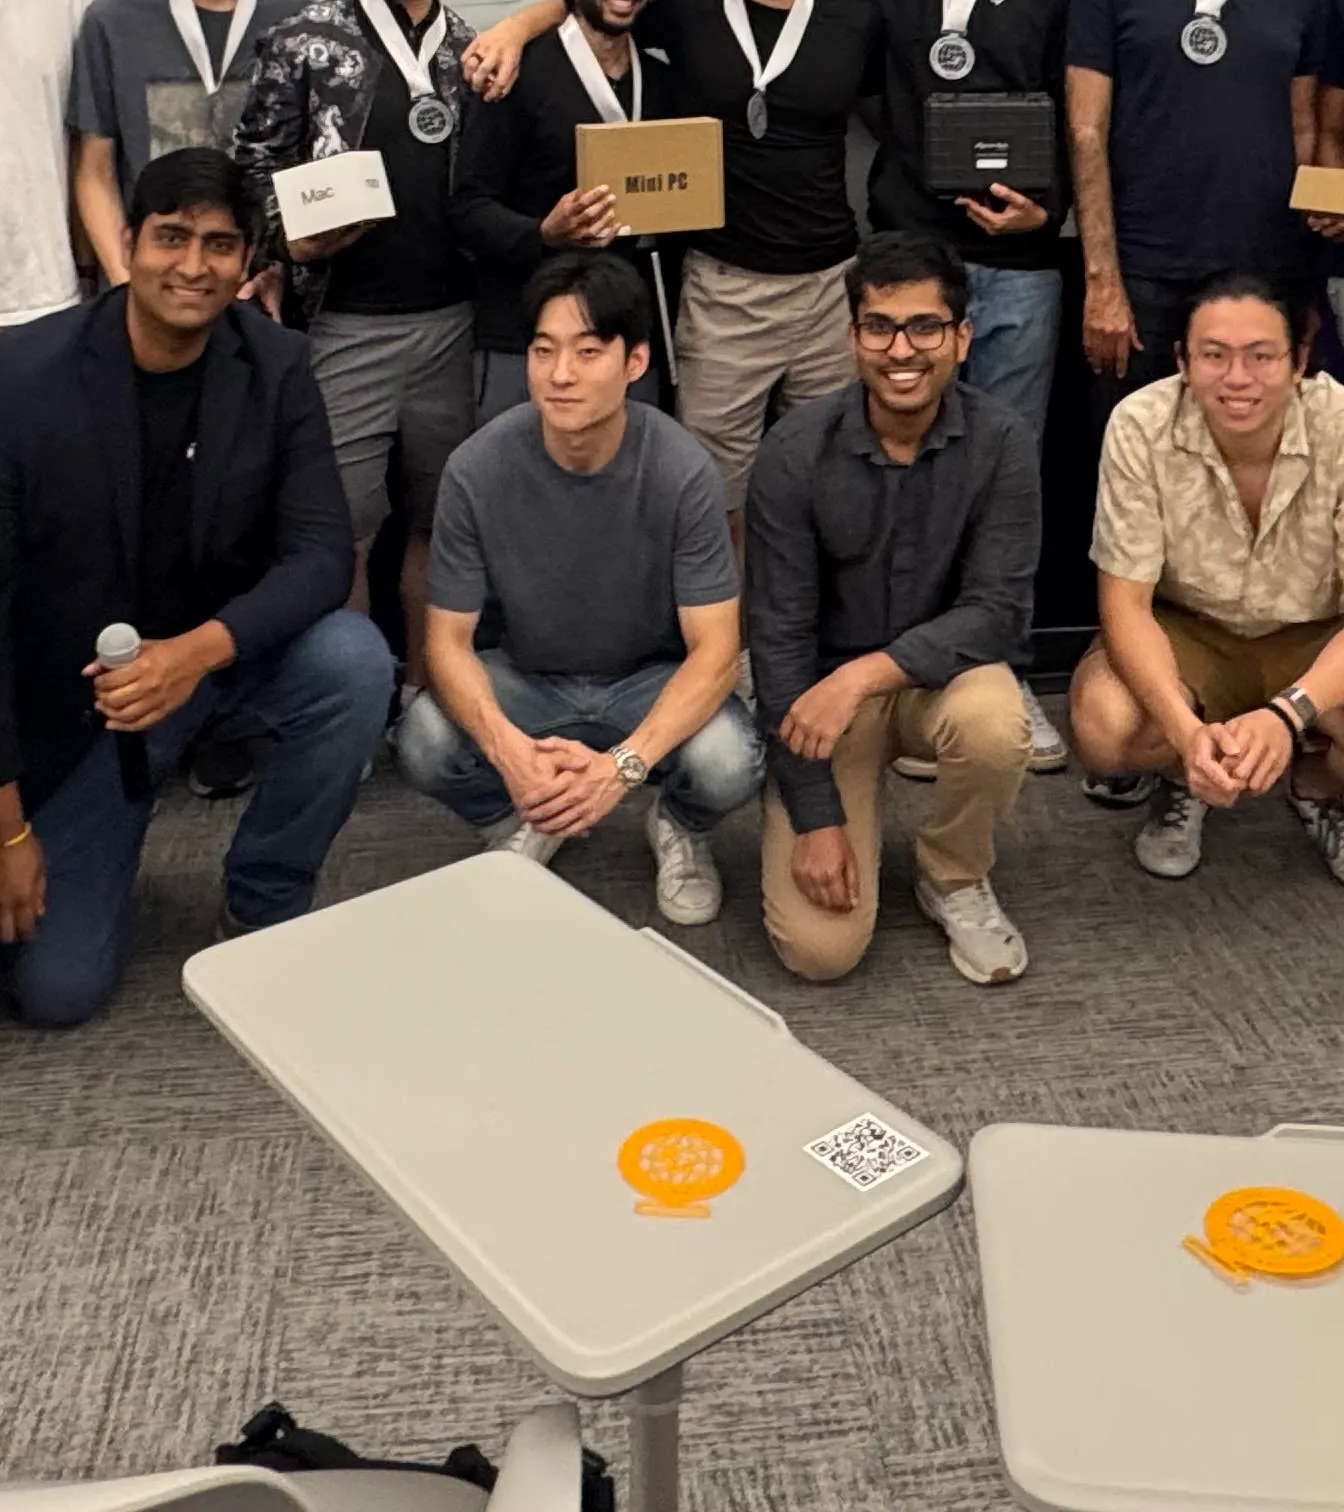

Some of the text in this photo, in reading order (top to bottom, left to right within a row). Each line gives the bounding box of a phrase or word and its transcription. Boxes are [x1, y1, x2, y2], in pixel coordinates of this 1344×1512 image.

[625, 172, 688, 194] Mini PC
[301, 187, 335, 205] Mac
